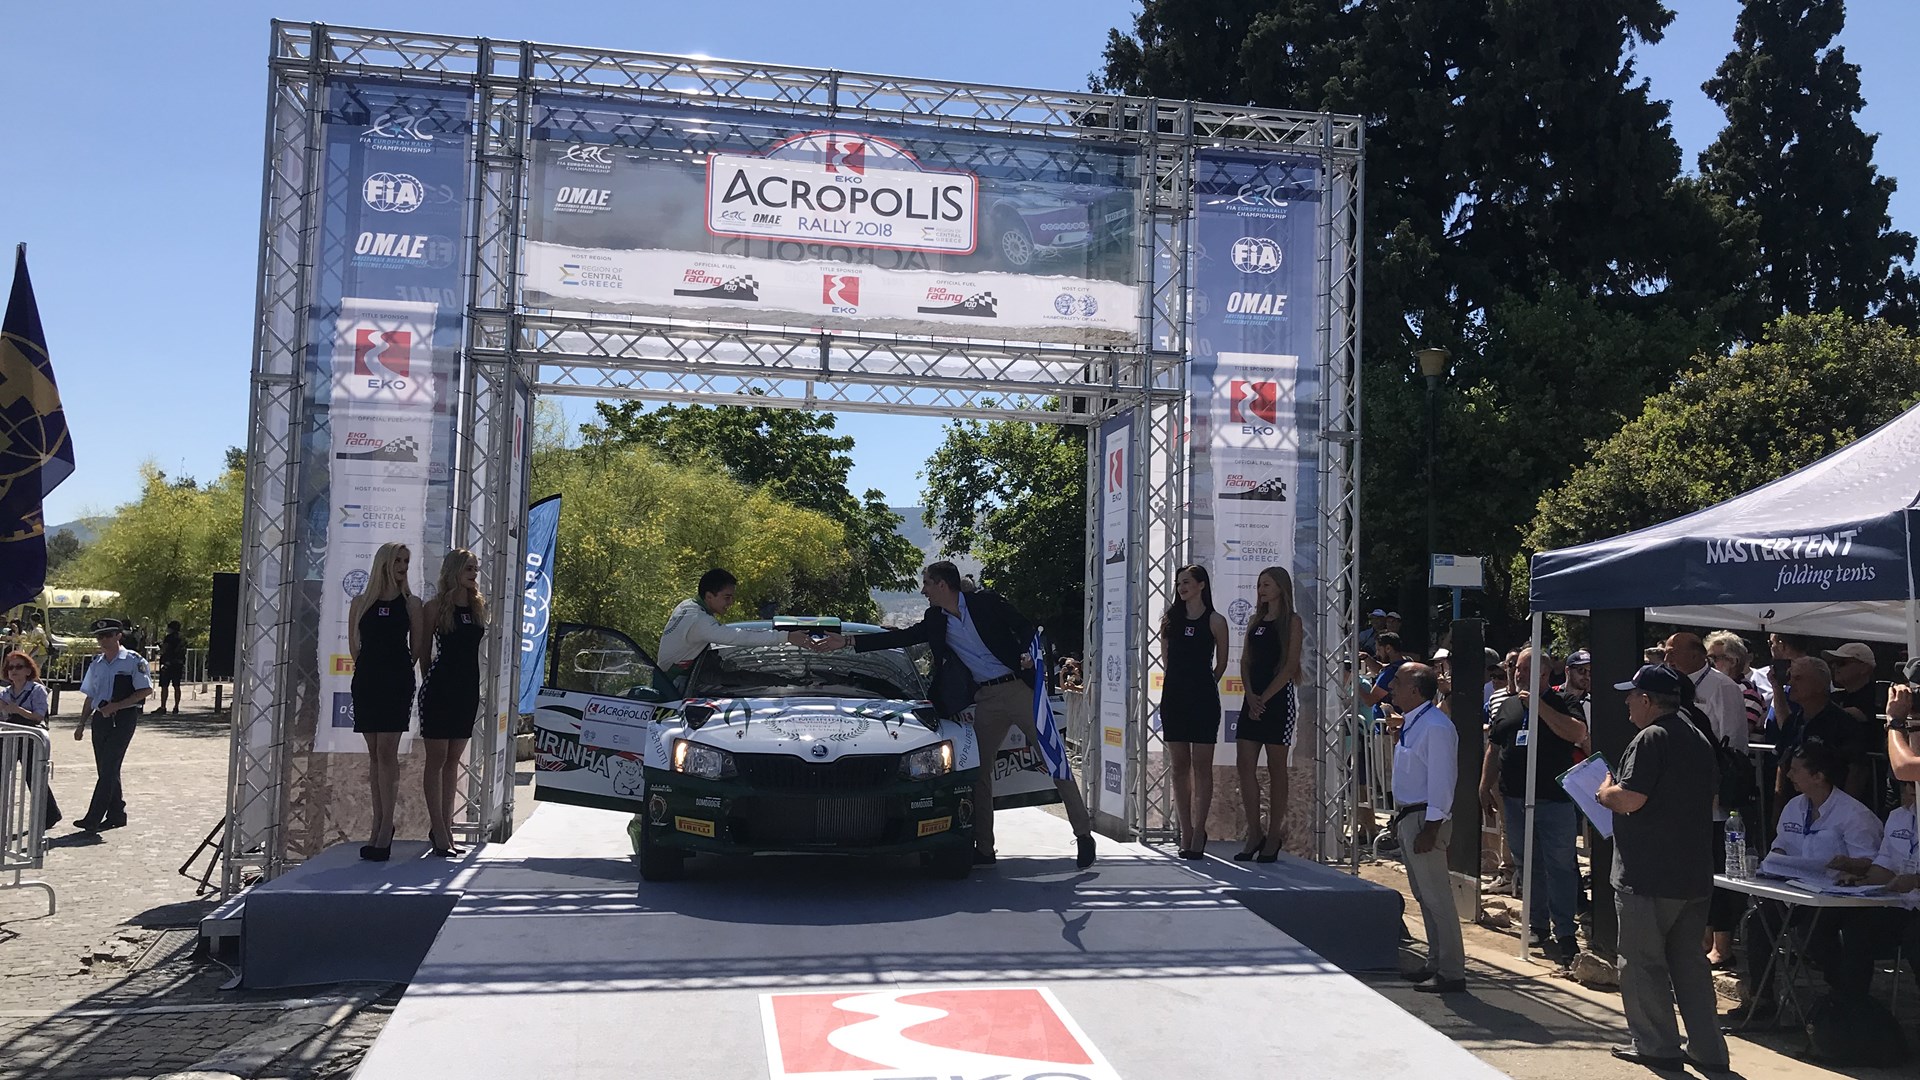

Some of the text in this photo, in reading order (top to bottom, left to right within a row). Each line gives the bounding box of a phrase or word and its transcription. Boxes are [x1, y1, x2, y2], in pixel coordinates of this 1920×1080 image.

[371, 144, 431, 153] CHAMPIONSHIP
[412, 140, 432, 148] RALLY
[835, 175, 863, 184] EKO
[557, 186, 611, 206] OMAE
[721, 169, 963, 221] ACROPOLIS
[752, 213, 782, 225] OMAE
[1236, 211, 1287, 220] CHAMPIONSHIP
[798, 216, 893, 237] RALLY 2018
[354, 232, 428, 259] OMAE
[581, 265, 611, 273] REGION
[685, 268, 706, 276] EKO
[581, 271, 623, 281] CENTRAL
[683, 274, 723, 287] racing
[581, 279, 623, 289] GREECE
[723, 283, 738, 291] 100
[928, 286, 947, 294] EKO
[926, 292, 963, 304] racing
[964, 301, 978, 309] 100
[1226, 291, 1288, 316] OMAE
[831, 306, 857, 315] EKO
[367, 379, 407, 390] EKO
[1241, 426, 1274, 436] EKO
[345, 438, 384, 449] racing
[1225, 479, 1257, 490] racing
[362, 512, 406, 521] CENTRAL
[362, 521, 406, 529] GREECE
[1241, 547, 1279, 555] CENTRAL
[1241, 554, 1280, 563] GREECE
[1774, 562, 1877, 592] folding tents
[598, 705, 650, 720] ACROPOLIS
[534, 726, 610, 778] IRINHA
[655, 742, 669, 765] TUTTI
[679, 819, 711, 834] PIRELLI
[921, 820, 949, 834] PIRELLI
